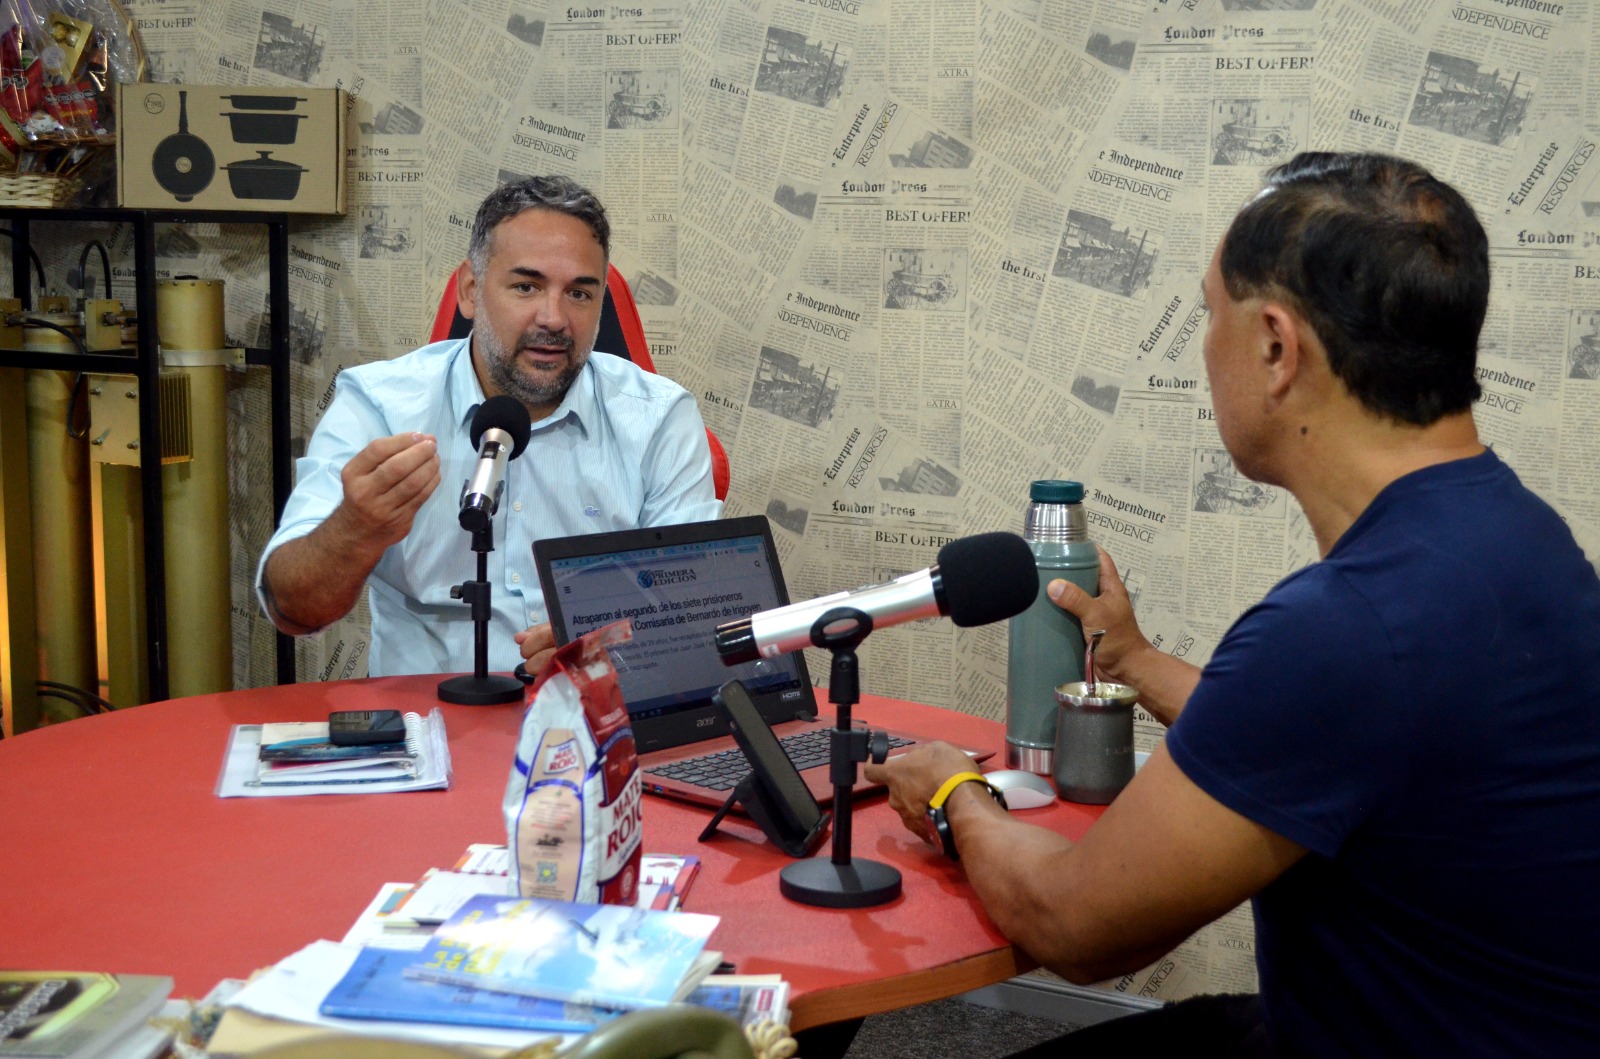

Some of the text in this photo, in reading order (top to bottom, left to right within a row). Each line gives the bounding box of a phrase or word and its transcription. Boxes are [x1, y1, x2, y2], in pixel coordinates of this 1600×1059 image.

[138, 19, 160, 29] BEST
[606, 34, 636, 46] BEST
[218, 57, 232, 68] the
[1215, 57, 1253, 70] BEST
[709, 77, 728, 91] the
[1350, 108, 1371, 123] the
[857, 101, 898, 167] RESOURCES
[1108, 149, 1184, 180] Independence
[358, 172, 383, 182] BEST
[1540, 141, 1596, 215] RESOURCES
[449, 214, 464, 226] the
[885, 210, 918, 222] BEST
[1001, 260, 1021, 275] the
[704, 391, 721, 404] the
[848, 426, 888, 489] RESOURCES
[1092, 488, 1166, 524] Independence
[875, 531, 907, 544] BEST
[652, 568, 695, 580] PRIMERA
[573, 592, 743, 626] Atraparon al segundo de los siete prisioneros
[634, 615, 674, 631] Comisaría
[676, 613, 686, 624] de
[687, 608, 720, 622] Bernardo
[722, 606, 732, 617] de
[733, 603, 762, 616] Irigoyen
[782, 690, 801, 700] HDMI
[696, 717, 714, 728] acer
